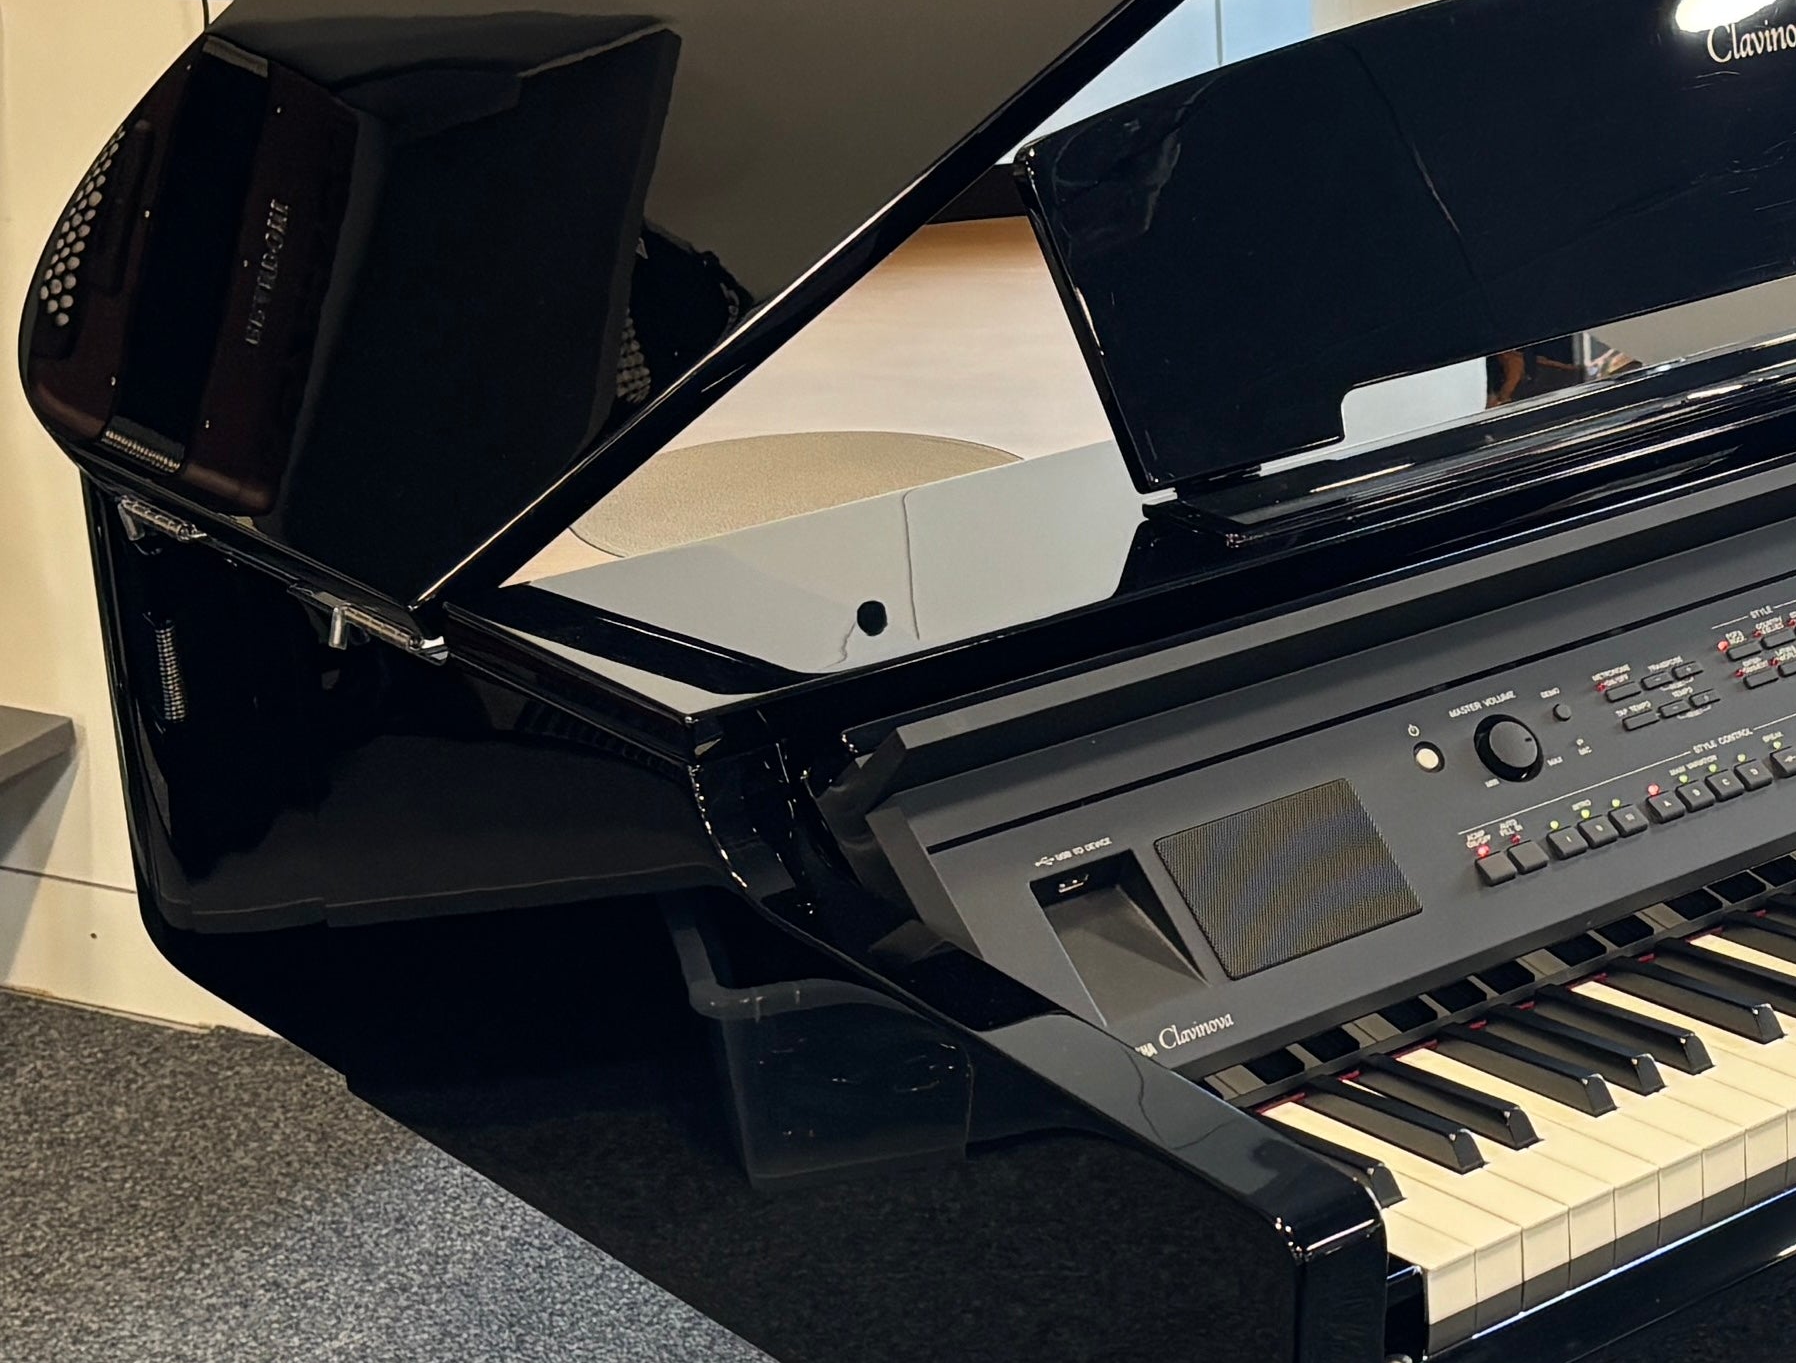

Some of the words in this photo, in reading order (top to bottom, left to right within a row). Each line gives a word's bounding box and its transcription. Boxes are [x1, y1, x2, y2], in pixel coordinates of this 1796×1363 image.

[1750, 605, 1774, 619] STYLE
[1449, 701, 1482, 717] MASTER
[1693, 740, 1718, 754] STYLE
[1718, 728, 1753, 745] CONTROL
[1159, 1013, 1234, 1049] Clavinova
